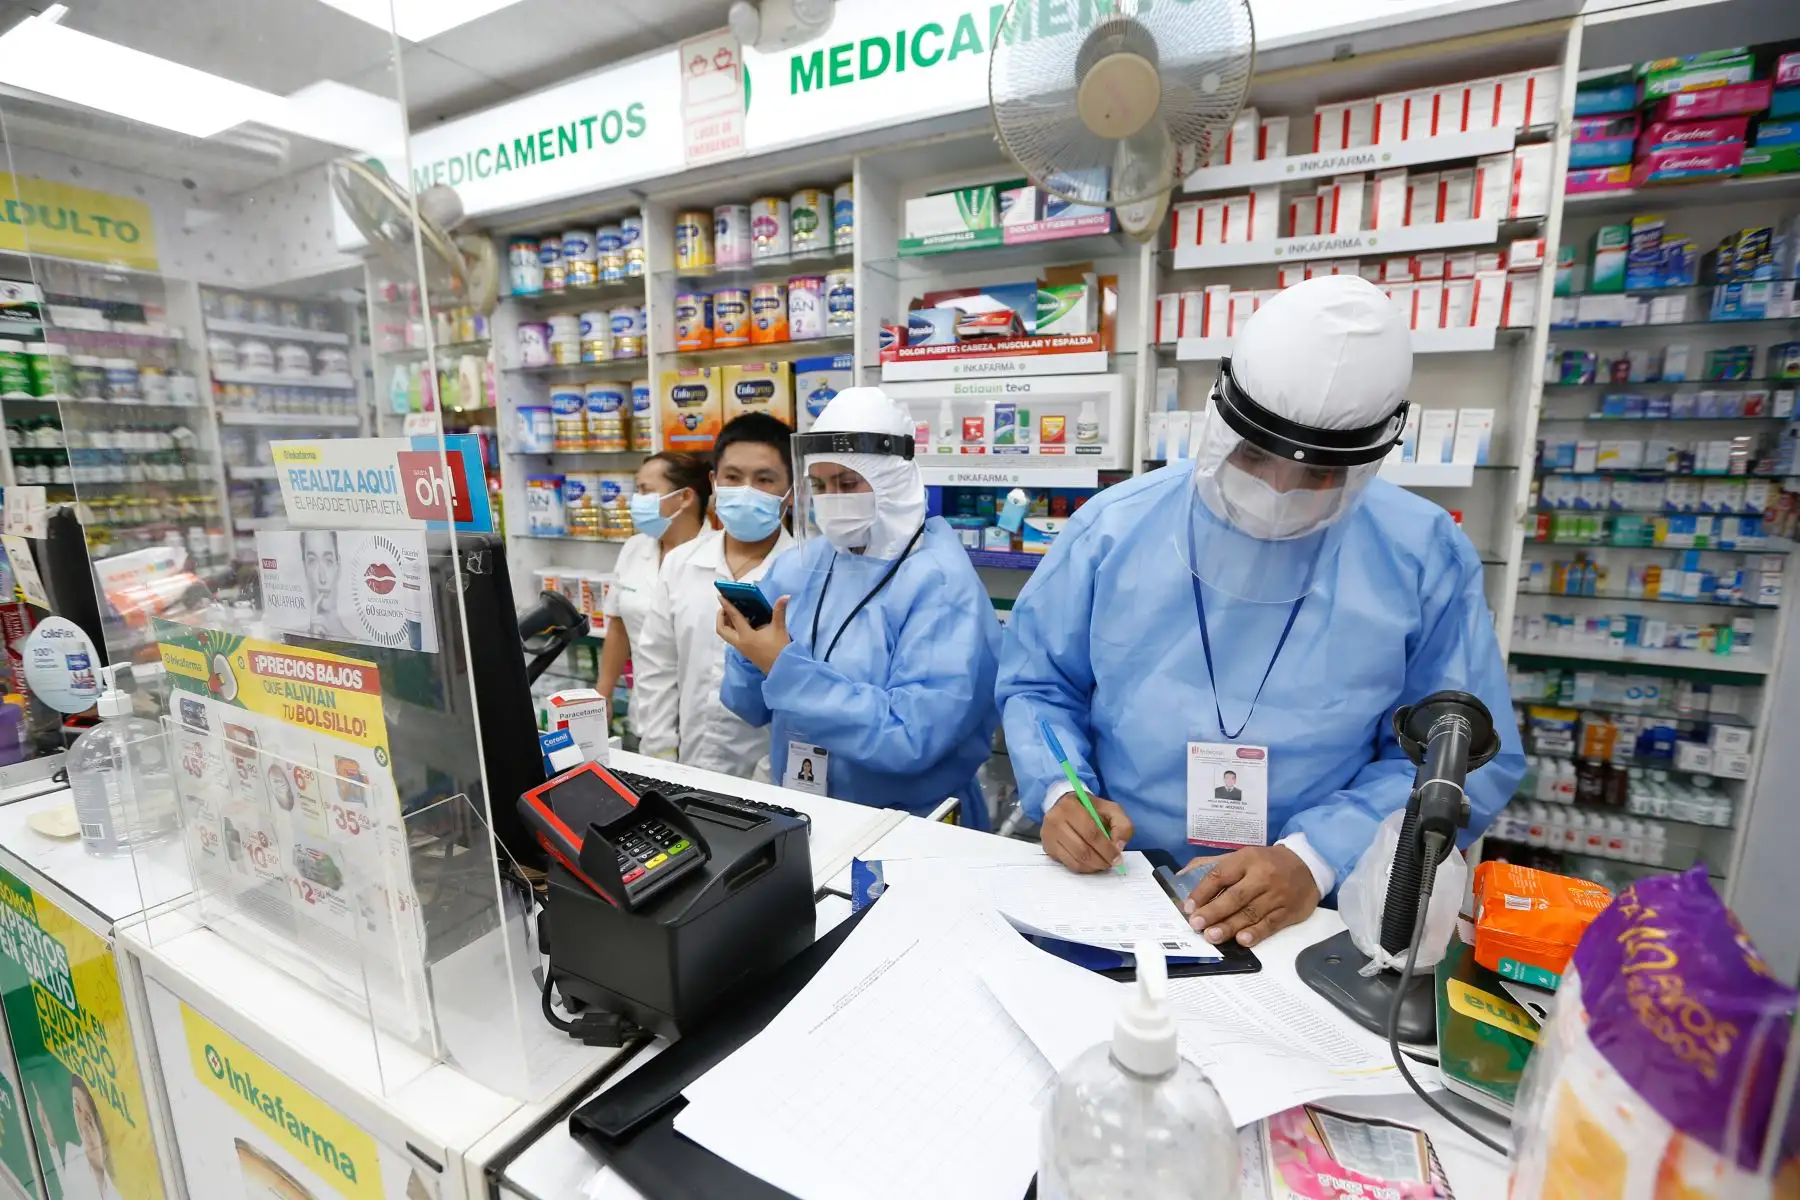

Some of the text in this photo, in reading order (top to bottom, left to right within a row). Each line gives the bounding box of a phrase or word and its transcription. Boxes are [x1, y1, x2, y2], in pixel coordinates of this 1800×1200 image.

[413, 102, 647, 192] MEDICAMENTOS
[1300, 153, 1375, 172] INKAFARMA
[0, 199, 139, 243] DULTO
[1288, 237, 1362, 255] INKAFARMA
[900, 347, 925, 357] DOLOR
[998, 339, 1042, 351] MUSCULAR
[1052, 336, 1093, 348] ESPALDA
[963, 362, 1015, 373] INKAFARMA
[1006, 383, 1031, 392] teva
[288, 464, 398, 495] REALIZA AQUÍ
[957, 473, 1008, 483] INKAFARMA
[294, 495, 404, 516] EL PAGO DE TU TARJETA
[268, 593, 307, 610] AQUAPHOR
[366, 604, 404, 618] 60 SEGUNDOS
[255, 654, 363, 689] ¡PRECIOS BAJOS
[263, 680, 337, 709] QUE ALIVIAN
[282, 703, 368, 738] TU BOLSILLO!
[560, 706, 604, 720] Paracetamol
[23, 943, 76, 1011] SALUD
[34, 985, 117, 1080] CUIDADO
[91, 1013, 108, 1043] EN
[42, 1016, 136, 1129] PERSONAL
[224, 1056, 358, 1184] Inkafarma
